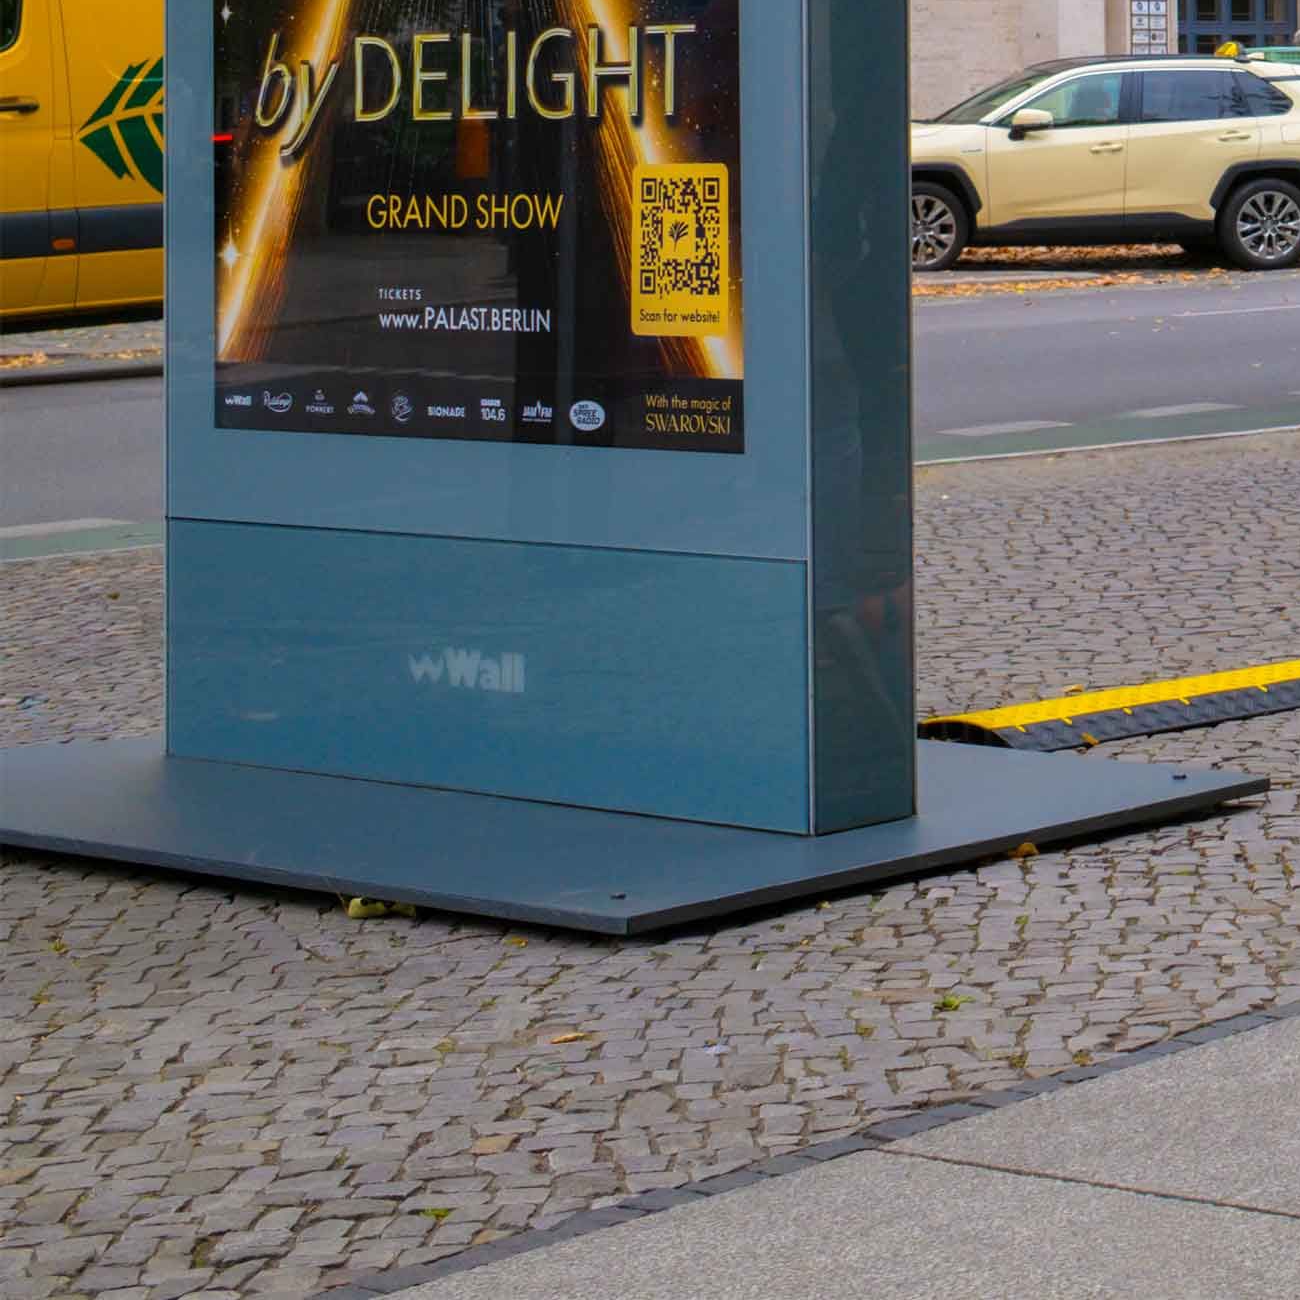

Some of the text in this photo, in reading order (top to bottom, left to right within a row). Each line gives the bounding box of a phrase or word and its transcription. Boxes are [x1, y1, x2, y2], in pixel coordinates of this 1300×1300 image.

[254, 22, 698, 158] by DELIGHT
[366, 193, 565, 230] GRAND SHOW
[378, 288, 423, 301] TICKETS
[378, 306, 551, 333] www.PALAST.BERLIN
[639, 308, 720, 323] Scan for website!
[645, 393, 732, 413] With the magic of
[645, 412, 731, 435] SWAROVSKI
